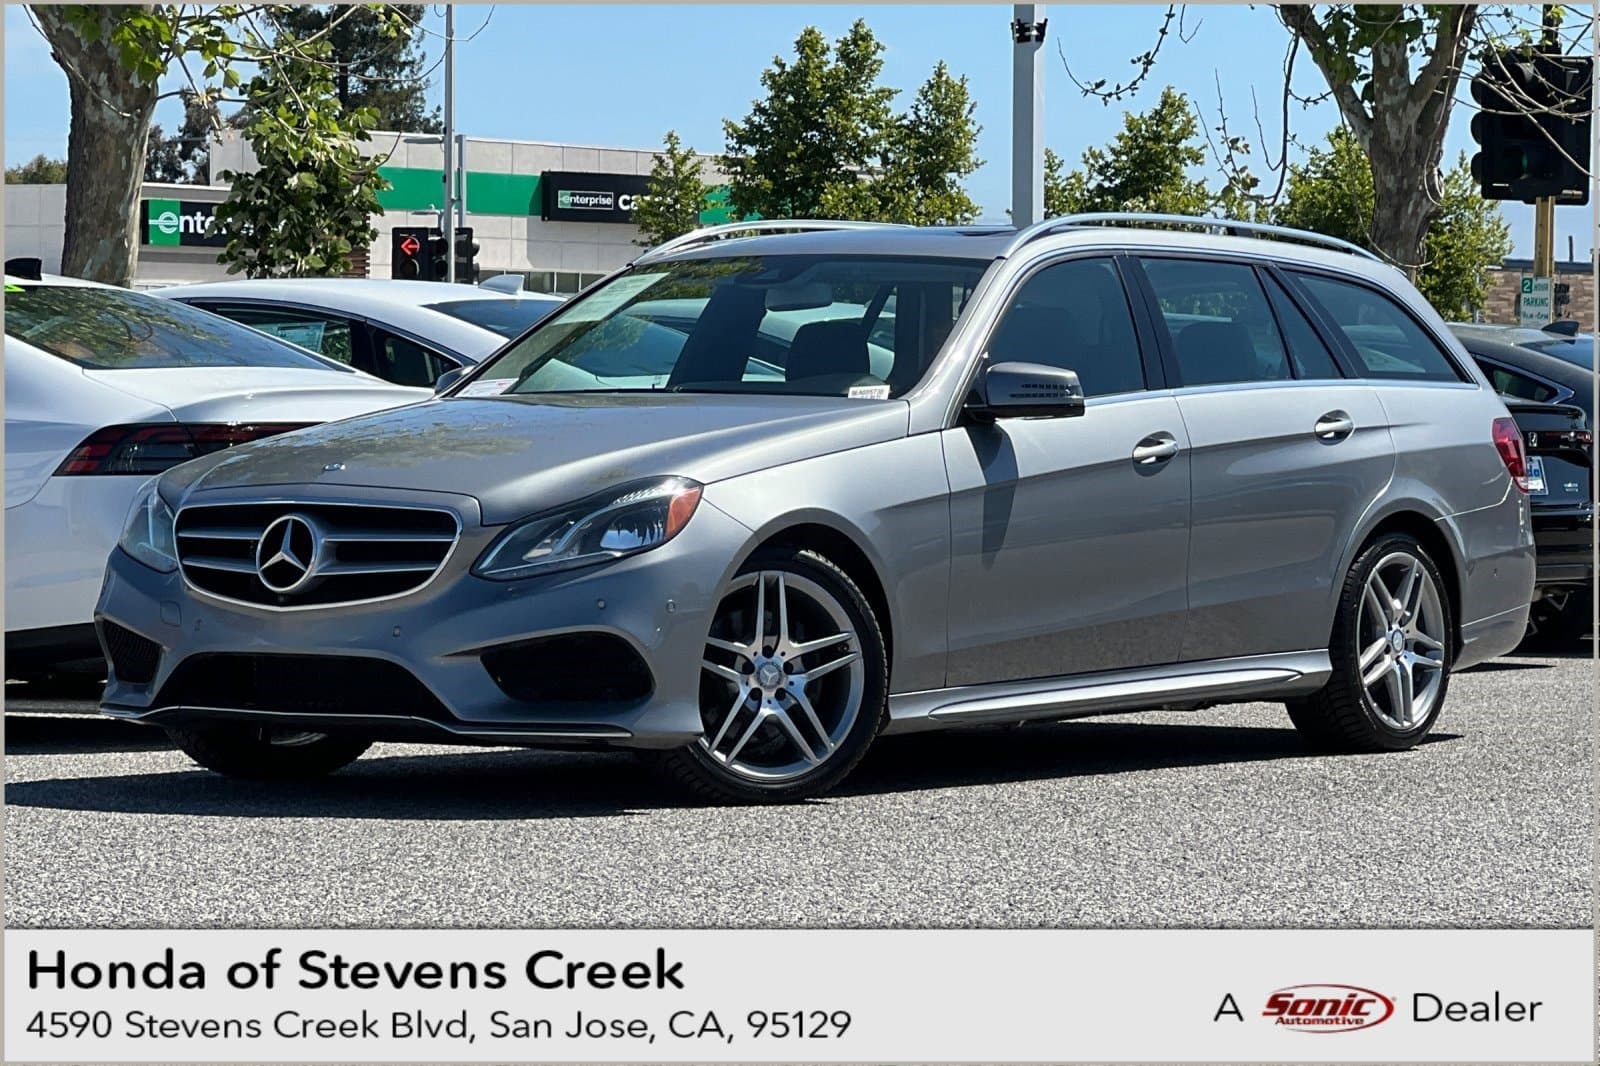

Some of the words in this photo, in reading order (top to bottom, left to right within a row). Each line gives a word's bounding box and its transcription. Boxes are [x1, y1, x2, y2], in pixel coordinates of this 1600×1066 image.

[561, 194, 612, 206] enterprise
[1523, 279, 1532, 292] 2
[1523, 297, 1549, 307] PARKING
